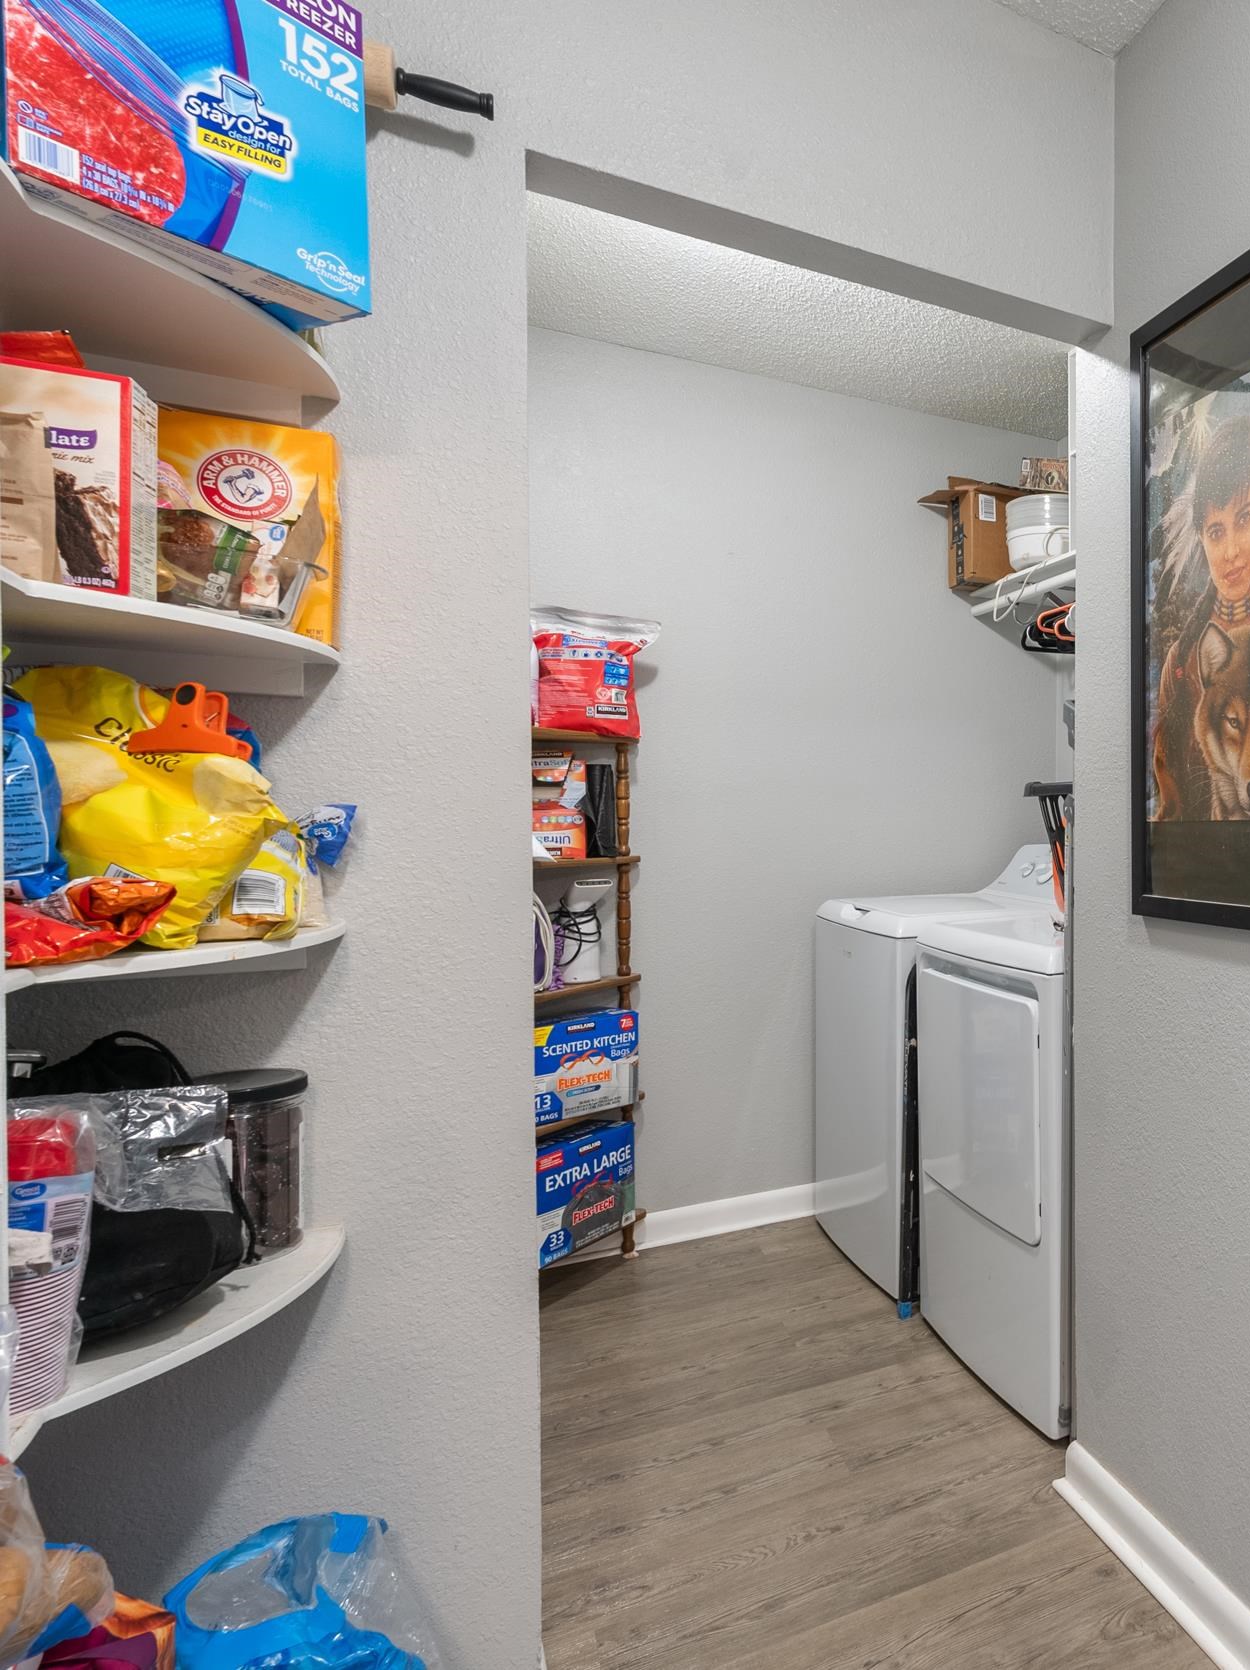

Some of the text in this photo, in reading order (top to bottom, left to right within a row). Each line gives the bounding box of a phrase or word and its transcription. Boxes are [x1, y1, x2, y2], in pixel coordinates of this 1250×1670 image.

[276, 0, 356, 49] REEZER
[278, 16, 359, 101] 152
[280, 59, 359, 113] TOTAL BAGS
[203, 133, 282, 168] EASY FILLING
[228, 130, 282, 154] design for
[305, 260, 360, 292] Technology
[337, 265, 366, 287] Seal
[202, 453, 288, 498] ARM & HAMMER
[567, 1022, 595, 1031] KIRKLAND
[620, 1018, 626, 1029] 7
[542, 1032, 636, 1058] SCENTED KITCHEN
[611, 1048, 630, 1058] Bags
[540, 1112, 559, 1121] BAGS
[545, 1162, 591, 1193] EXTRA
[594, 1144, 631, 1174] LARGE
[618, 1164, 633, 1177] Bags
[549, 1230, 565, 1248] 33
